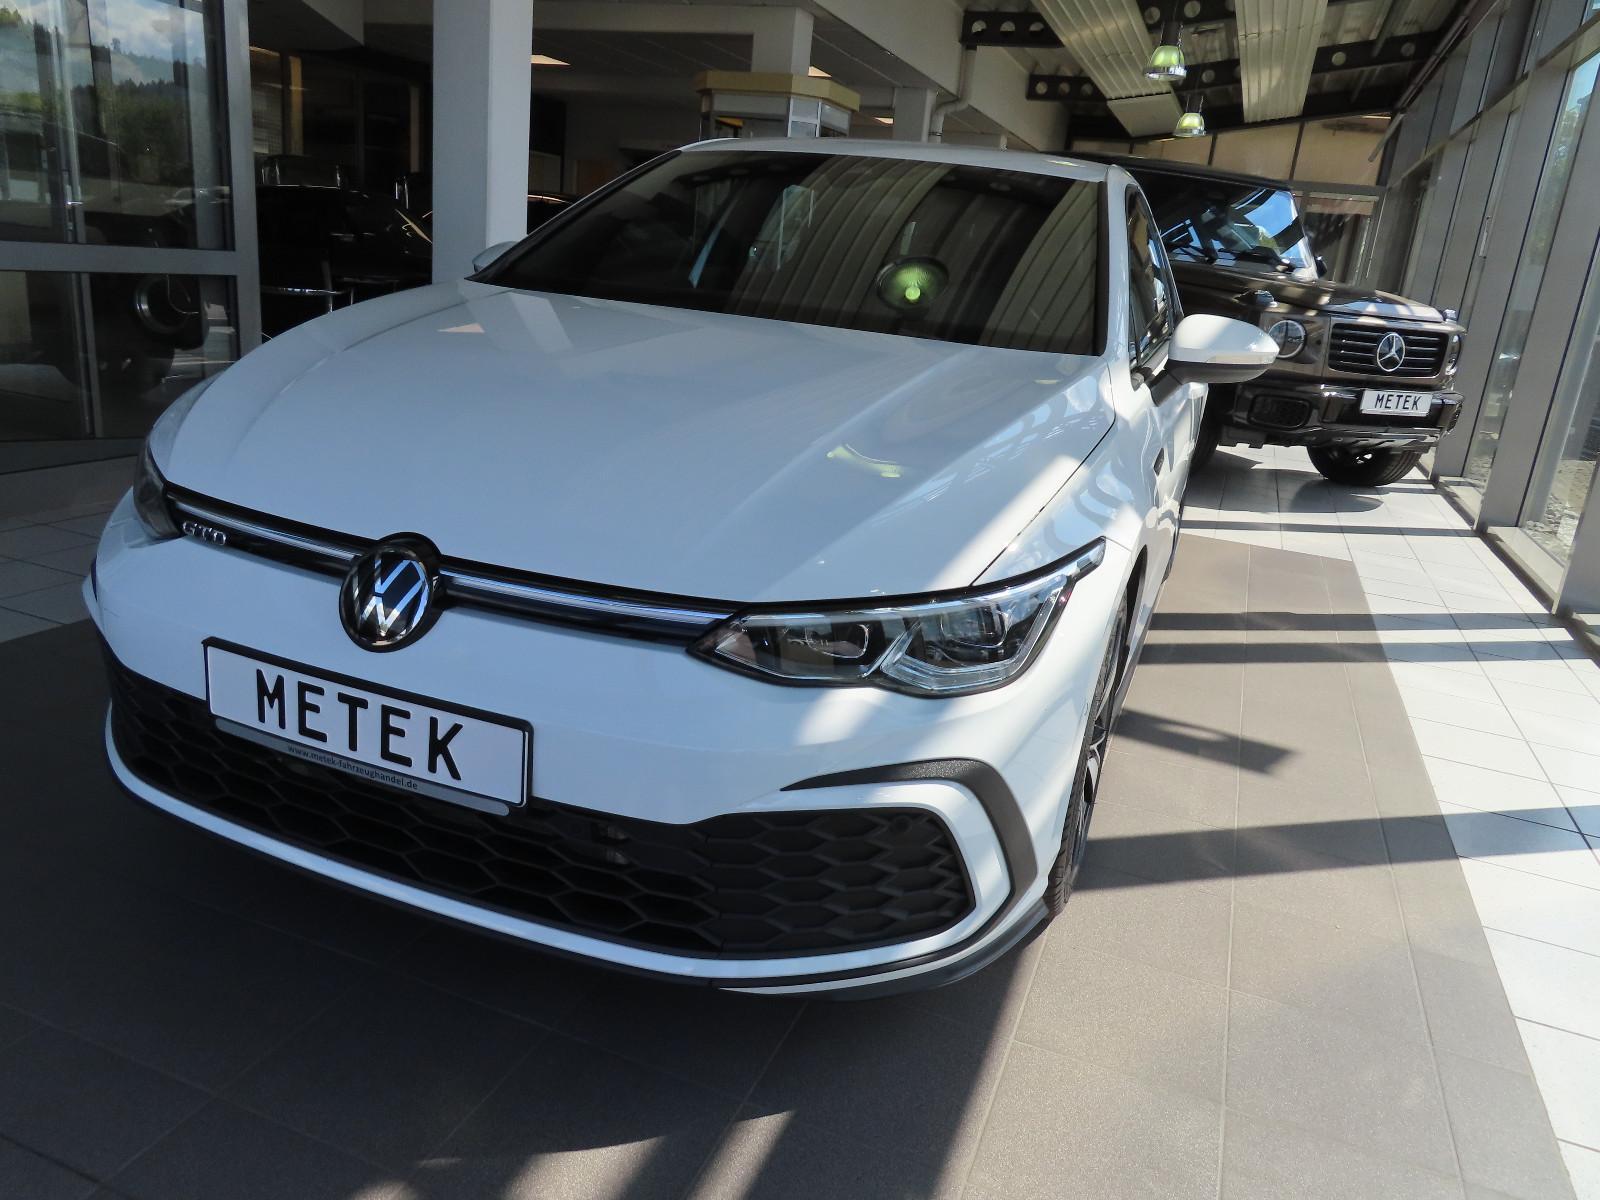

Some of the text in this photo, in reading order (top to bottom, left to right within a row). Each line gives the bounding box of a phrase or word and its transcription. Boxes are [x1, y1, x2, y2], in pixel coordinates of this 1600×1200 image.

[1374, 393, 1422, 411] METEK
[182, 521, 227, 545] GTD
[256, 669, 464, 781] METEK
[287, 744, 419, 790] www.metek-fahrzeughandel.de
